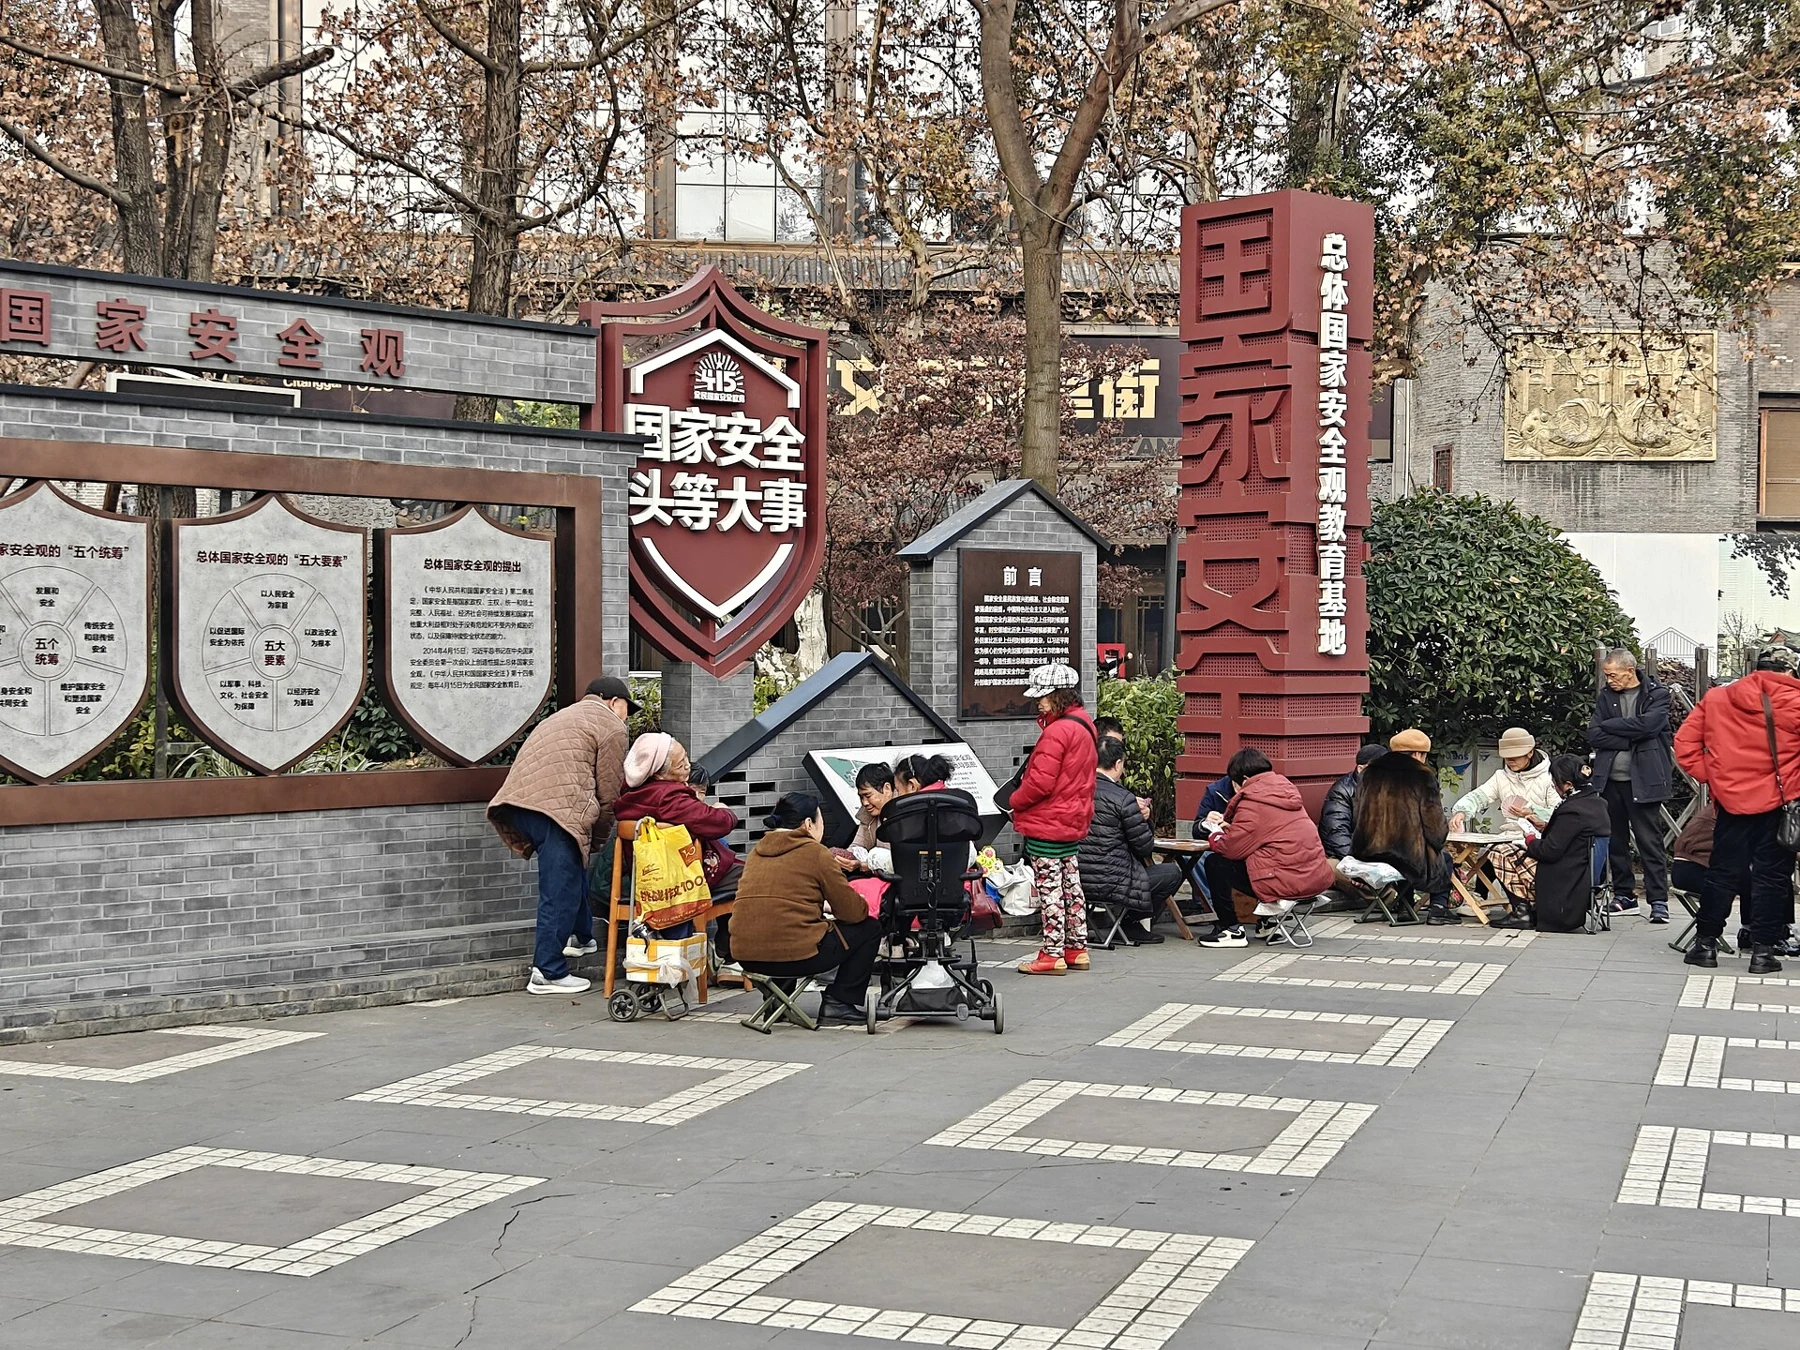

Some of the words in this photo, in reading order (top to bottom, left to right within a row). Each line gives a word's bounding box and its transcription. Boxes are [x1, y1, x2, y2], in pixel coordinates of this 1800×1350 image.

[0, 287, 406, 378] 国家安全观
[701, 369, 737, 392] 415
[623, 403, 806, 472] 国家安全
[1317, 232, 1349, 657] 总体国家安全观教育基地
[628, 468, 807, 533] 头等大事
[423, 558, 521, 573] 总体国家安全观的提出
[1003, 566, 1042, 587] 前言
[35, 587, 60, 595] 发展和
[260, 590, 295, 598] 以人民安全
[39, 599, 56, 607] 安全
[267, 601, 288, 609] 为宗旨
[84, 622, 115, 630] 传统安全
[209, 627, 246, 635] 以促进国际
[304, 628, 338, 637] 以政治安全
[84, 634, 115, 642] 和非传统
[35, 638, 59, 650] 五个
[209, 639, 246, 647] 安全为依托
[264, 640, 285, 651] 五大
[311, 639, 331, 647] 为根本
[91, 645, 107, 653] 安全
[35, 653, 59, 665] 统筹
[264, 655, 286, 666] 要素
[60, 683, 106, 691] 维护国家安全
[219, 691, 269, 699] 文化、社会安全
[287, 687, 321, 696] 以经济安全
[64, 695, 102, 703] 和塑造国家
[293, 699, 314, 707] 为基础
[75, 706, 91, 714] 安全
[233, 702, 255, 710] 为保障
